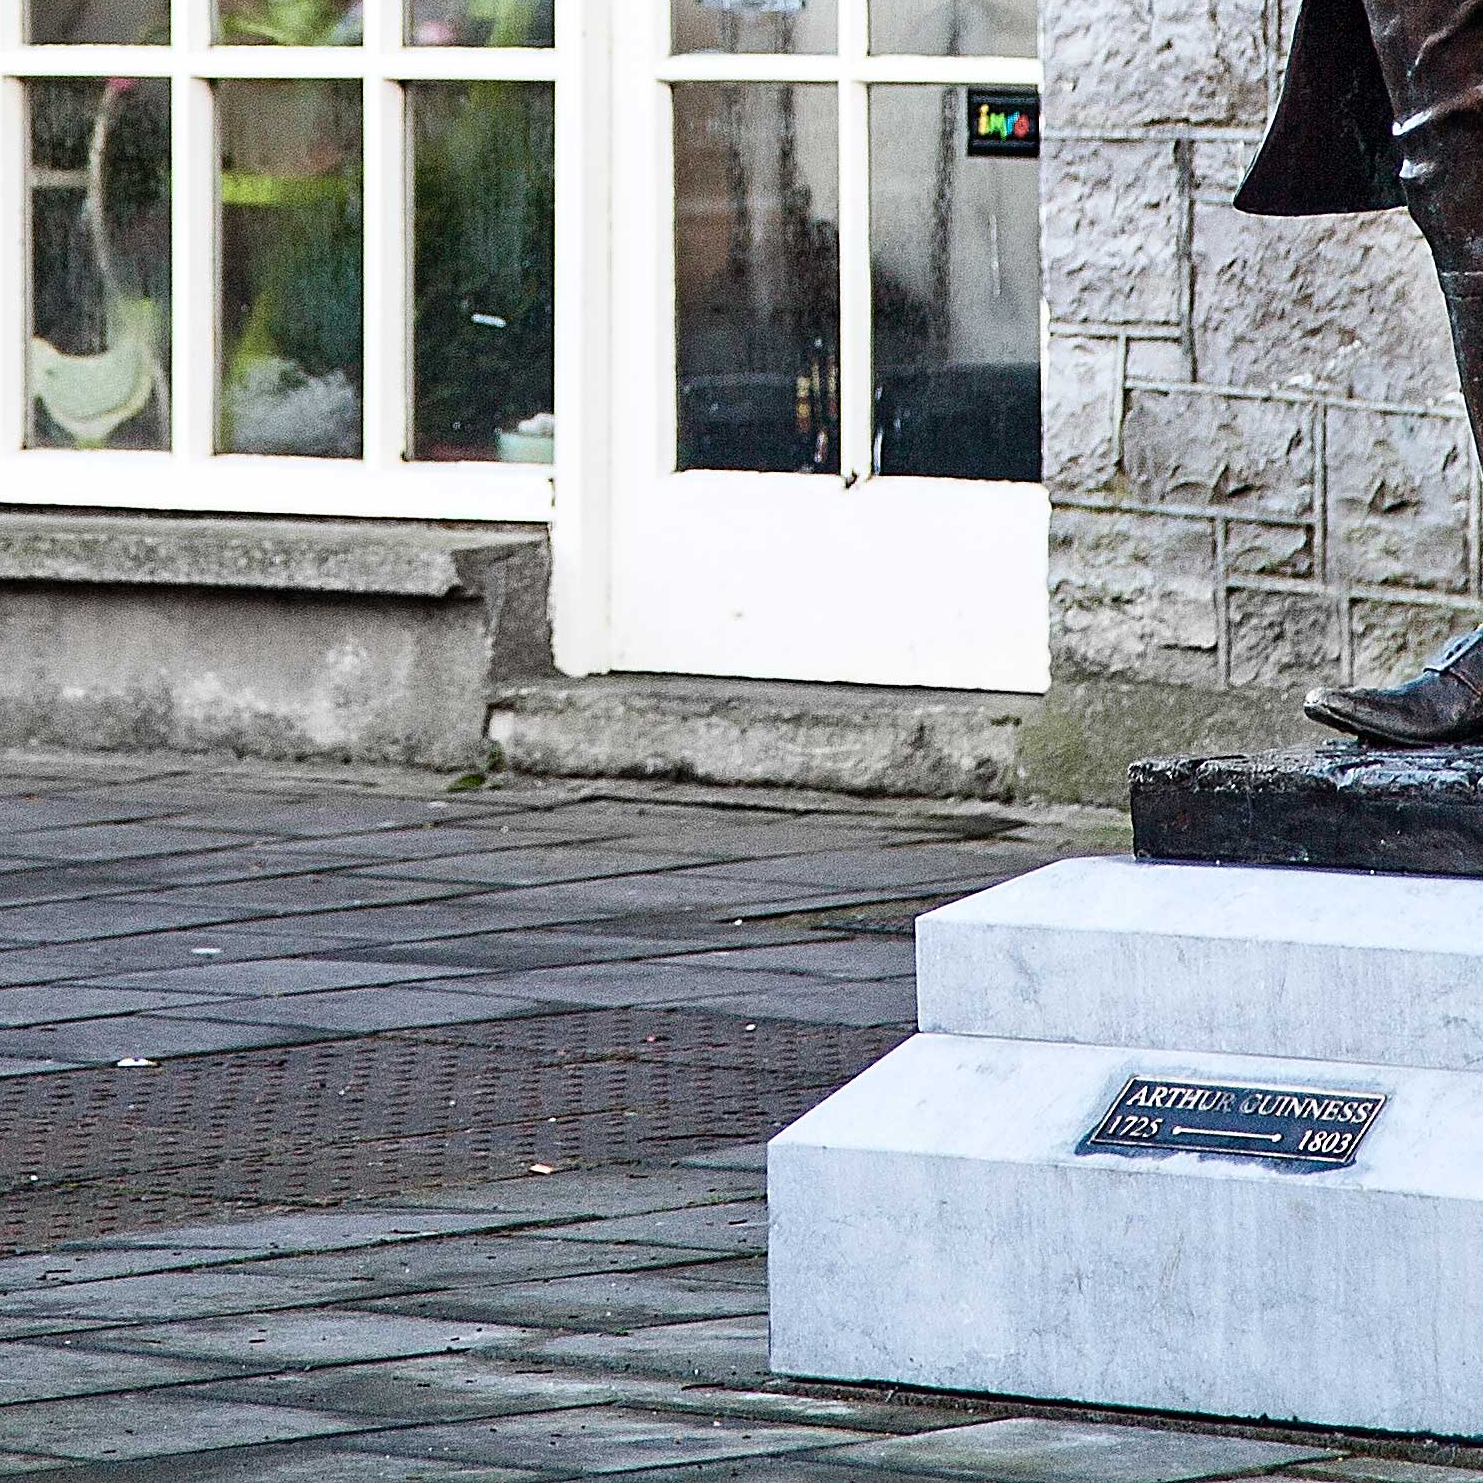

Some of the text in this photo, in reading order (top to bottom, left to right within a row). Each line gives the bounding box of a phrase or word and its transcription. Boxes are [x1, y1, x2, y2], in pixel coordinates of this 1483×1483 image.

[1126, 1085, 1375, 1124] ARTHUR GUINNESS
[1107, 1114, 1353, 1154] 1725 1803
